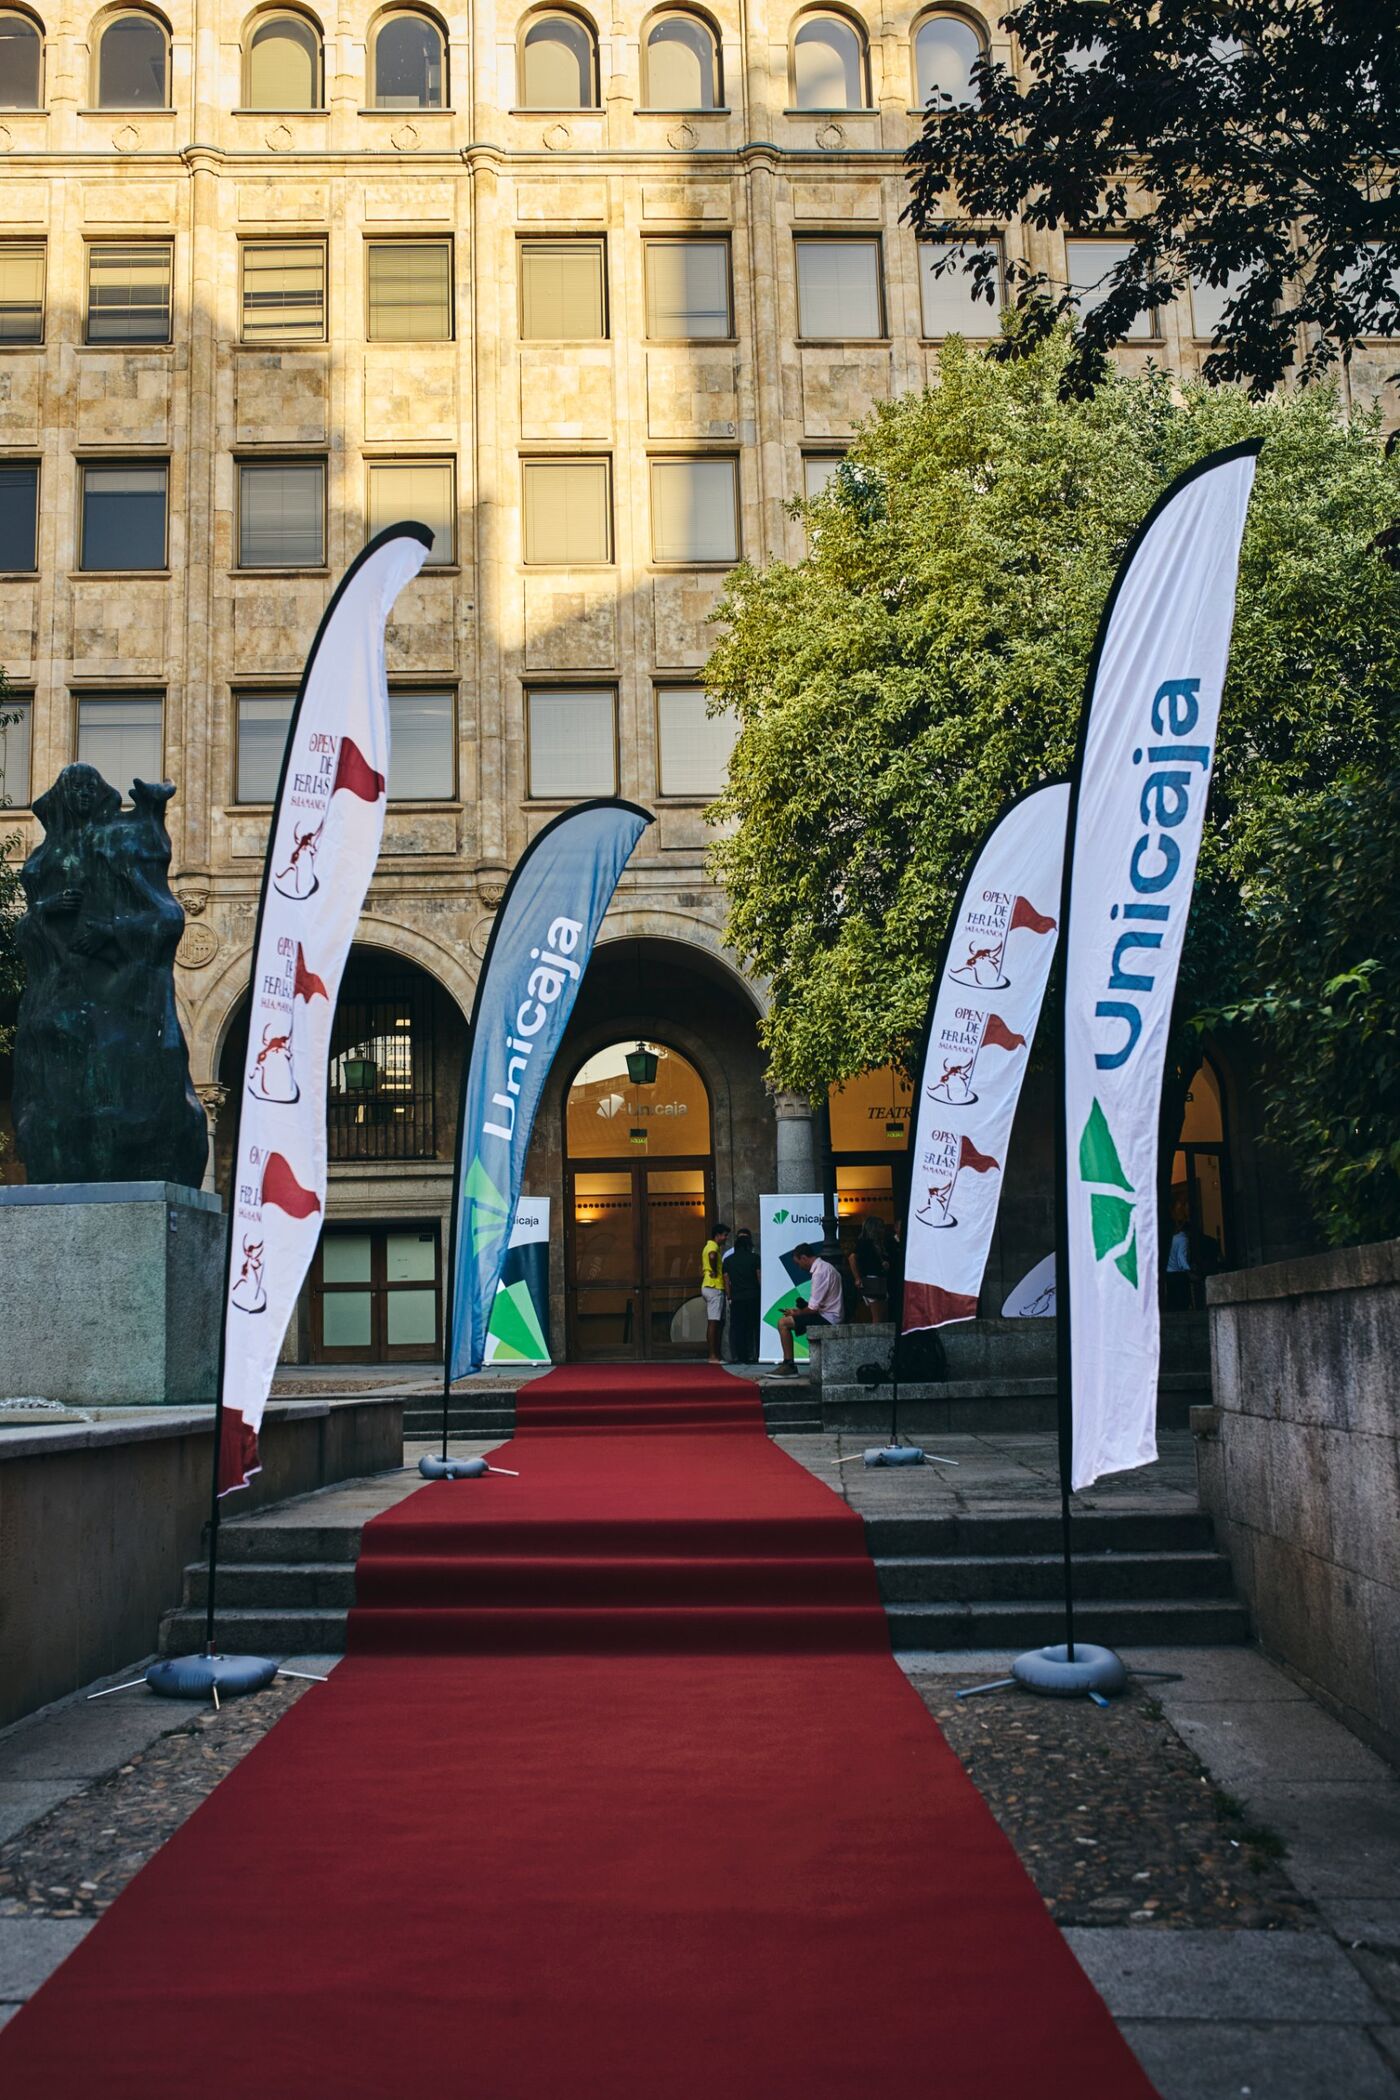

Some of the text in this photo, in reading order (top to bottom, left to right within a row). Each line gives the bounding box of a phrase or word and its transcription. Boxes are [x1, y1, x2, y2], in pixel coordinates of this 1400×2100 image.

[309, 732, 338, 754] OPEN
[320, 754, 334, 774] DE
[294, 773, 331, 796] FERIAS
[1094, 677, 1211, 1070] Unicaja
[983, 890, 1012, 904] OPEN
[995, 904, 1008, 916] DE
[968, 912, 1006, 928] FERIAS
[956, 1007, 984, 1021] OPEN
[482, 916, 584, 1141] Unicaja
[967, 1021, 980, 1033] DE
[941, 1029, 978, 1045] FERIAS
[868, 1106, 912, 1119] TEATR
[932, 1129, 958, 1144] OPEN
[945, 1144, 957, 1157] DE
[513, 1215, 540, 1228] icaja
[790, 1213, 823, 1226] Unicaj
